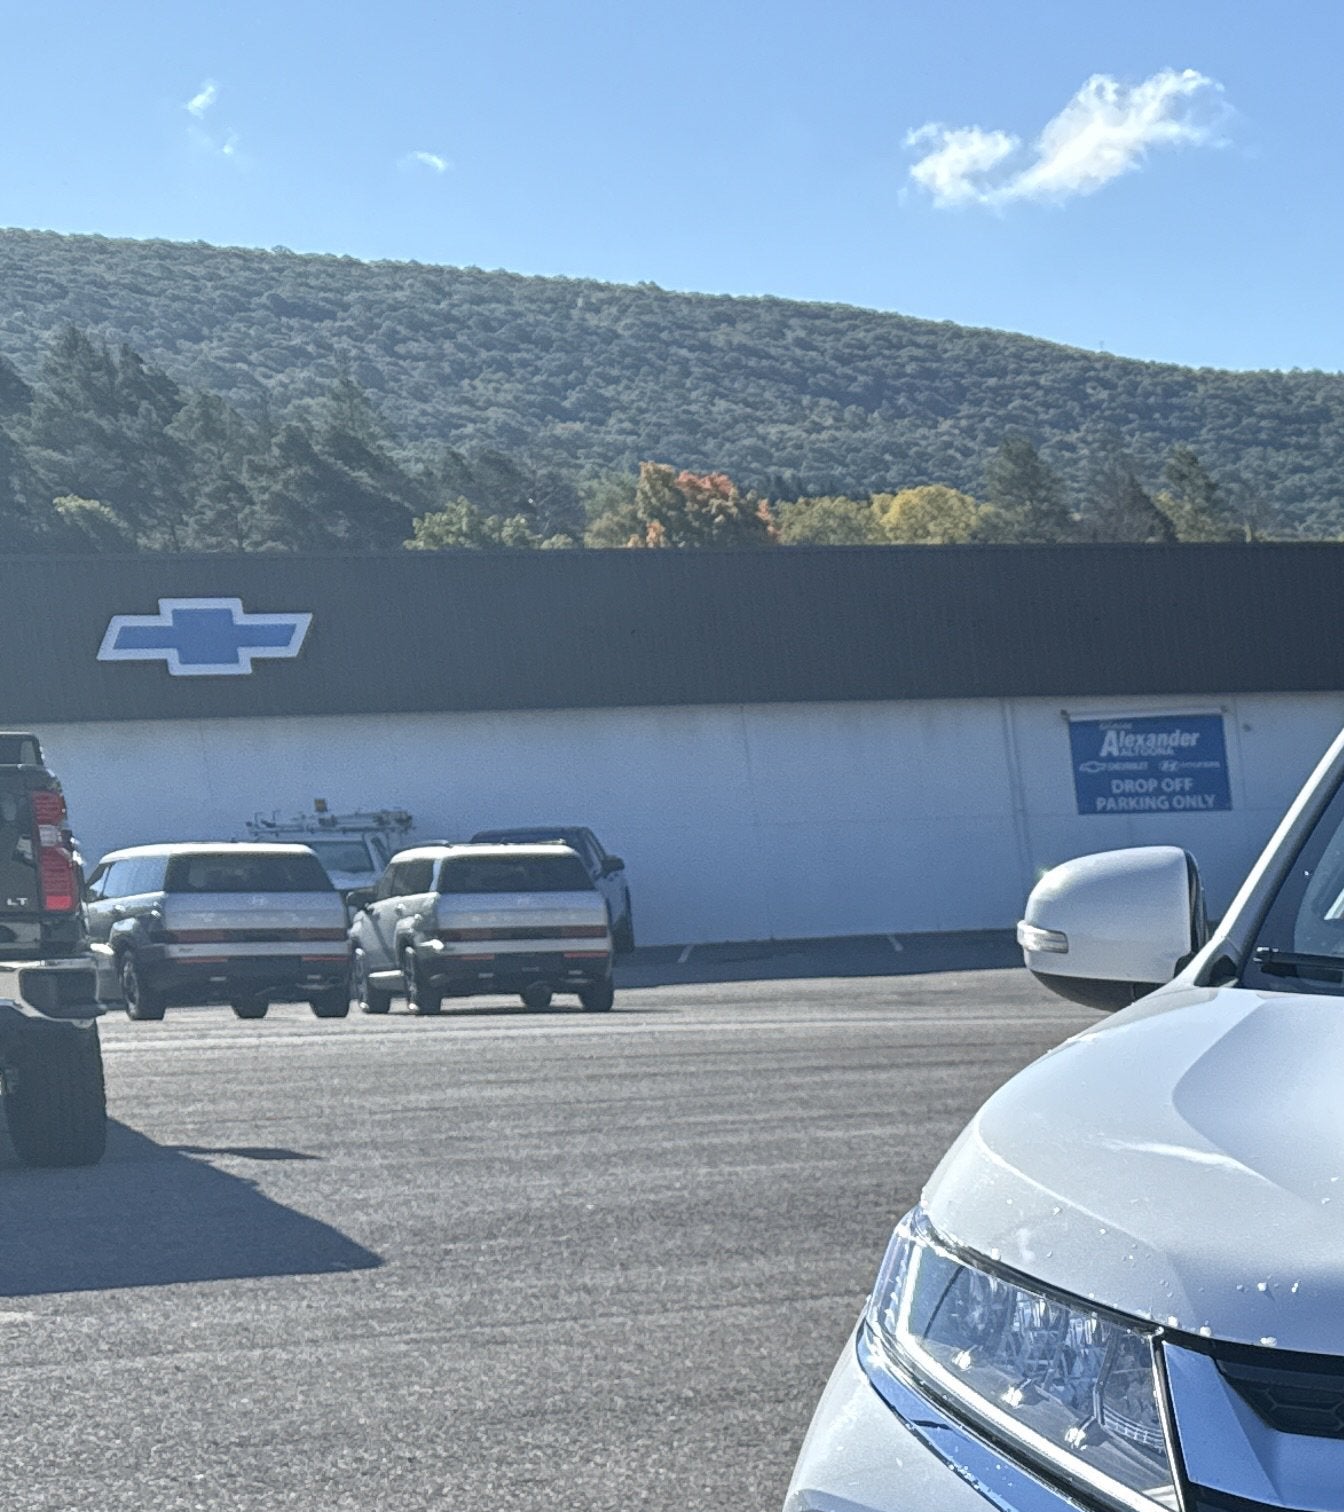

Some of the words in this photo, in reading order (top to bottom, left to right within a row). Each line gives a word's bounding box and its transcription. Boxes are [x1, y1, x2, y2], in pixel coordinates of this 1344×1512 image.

[1099, 729, 1200, 757] Alexander
[1111, 778, 1158, 794] DROP
[1161, 777, 1194, 792] OFF
[1096, 795, 1170, 811] PARKING
[1172, 794, 1216, 809] ONLY
[7, 897, 28, 906] LT
